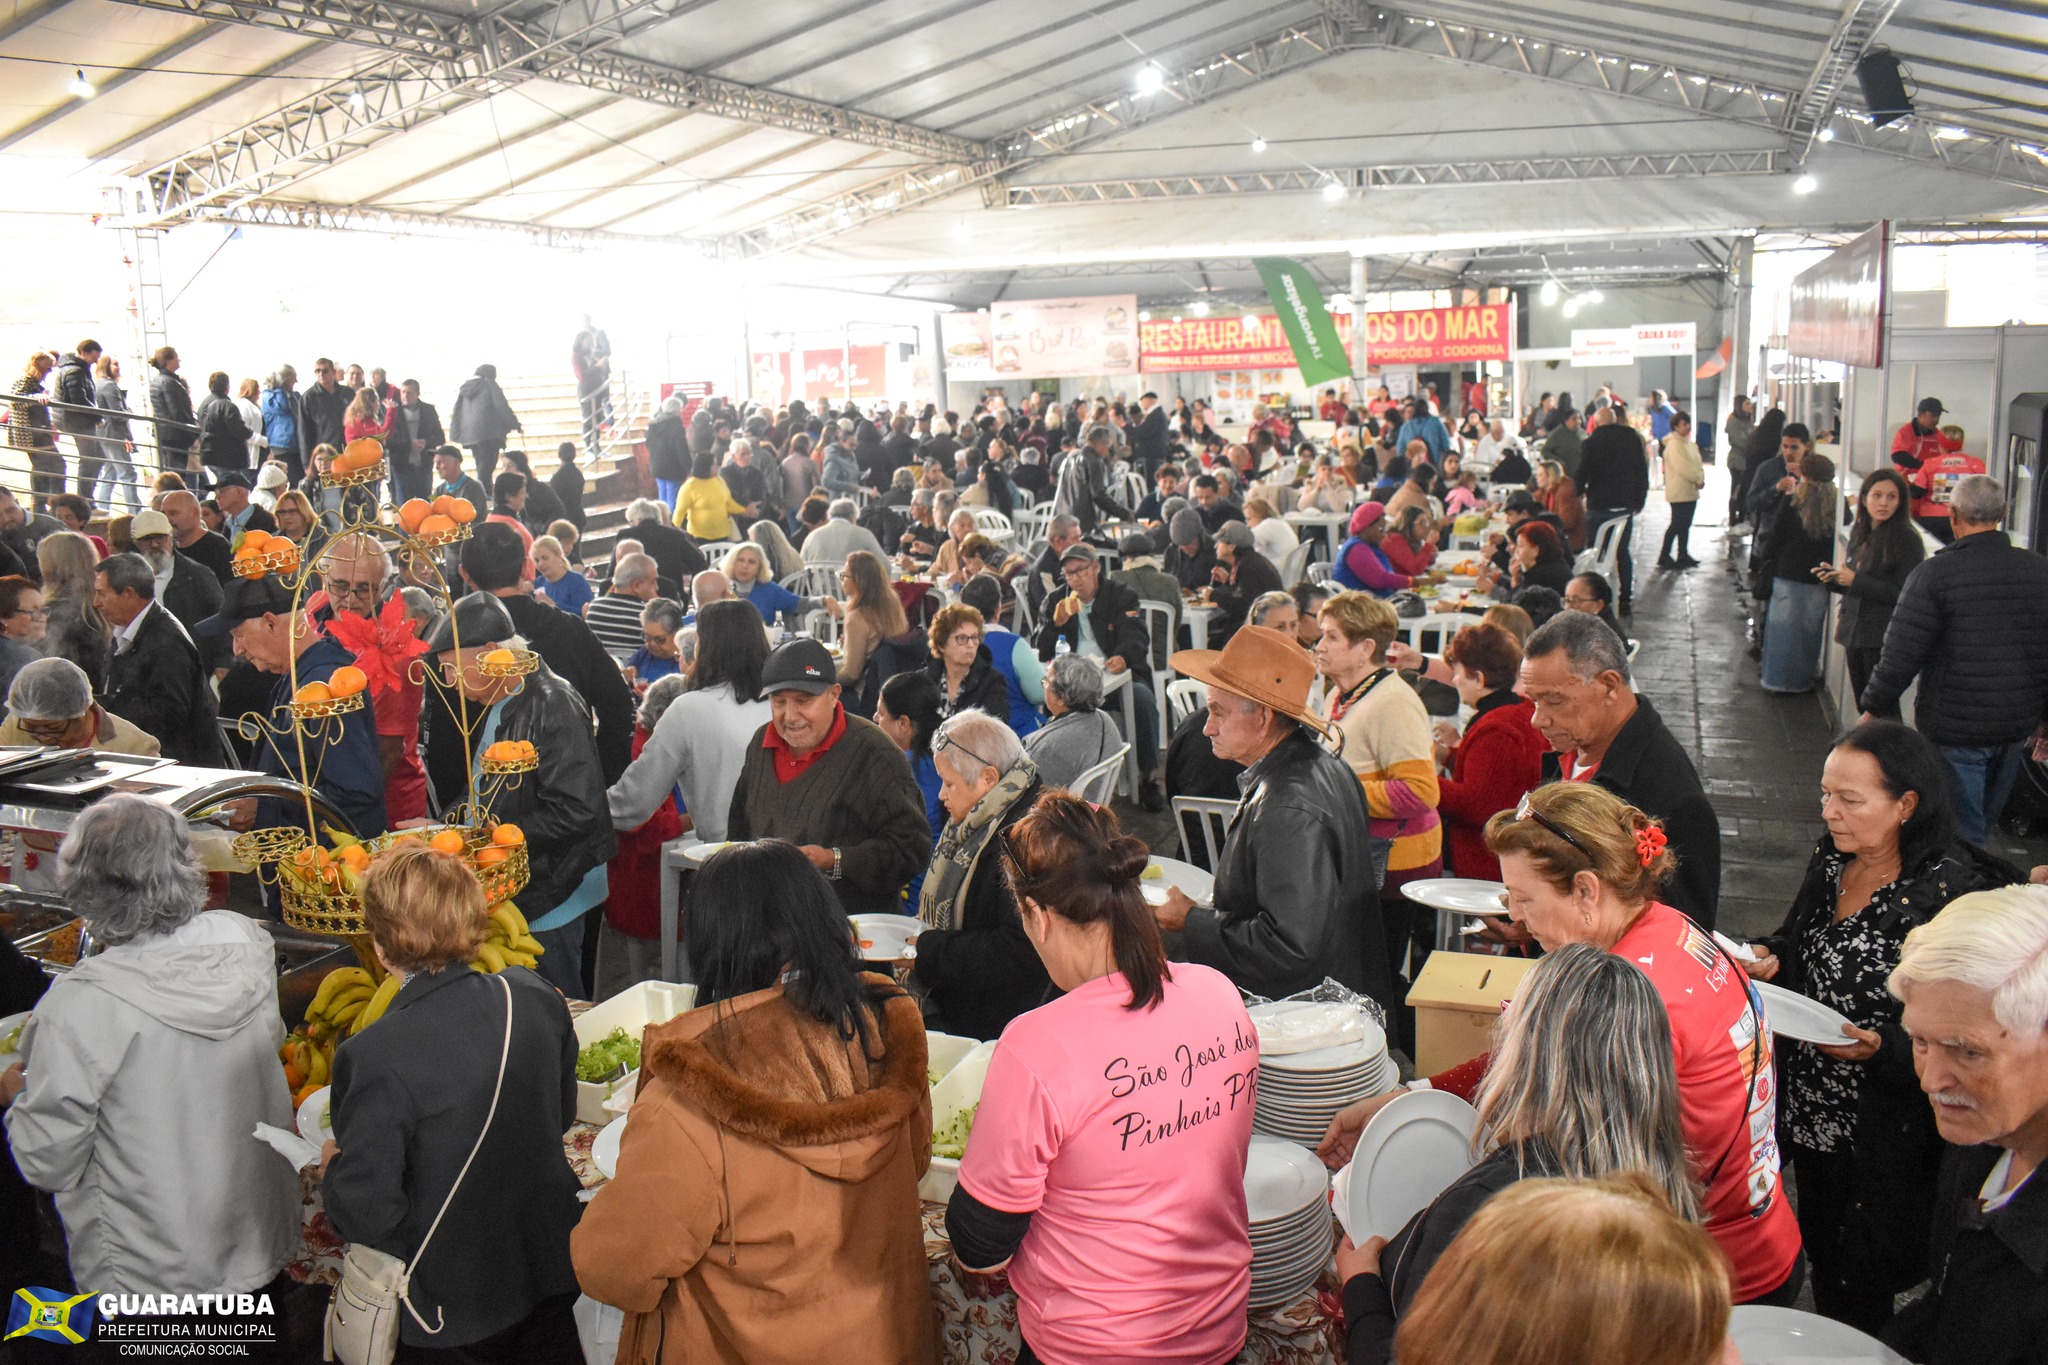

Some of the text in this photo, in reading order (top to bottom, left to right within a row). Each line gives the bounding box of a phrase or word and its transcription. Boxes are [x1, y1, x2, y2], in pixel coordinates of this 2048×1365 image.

[1141, 318, 1292, 353] RESTAURANT
[1403, 311, 1438, 342] DO
[1445, 308, 1498, 340] MAR
[1280, 273, 1323, 360] TV evangelizar
[1373, 345, 1433, 361] PORÇÕES
[1443, 343, 1506, 357] CODORNA
[1104, 1057, 1168, 1098] São
[1175, 1036, 1227, 1088] José
[1112, 1067, 1258, 1152] Pinhais PR
